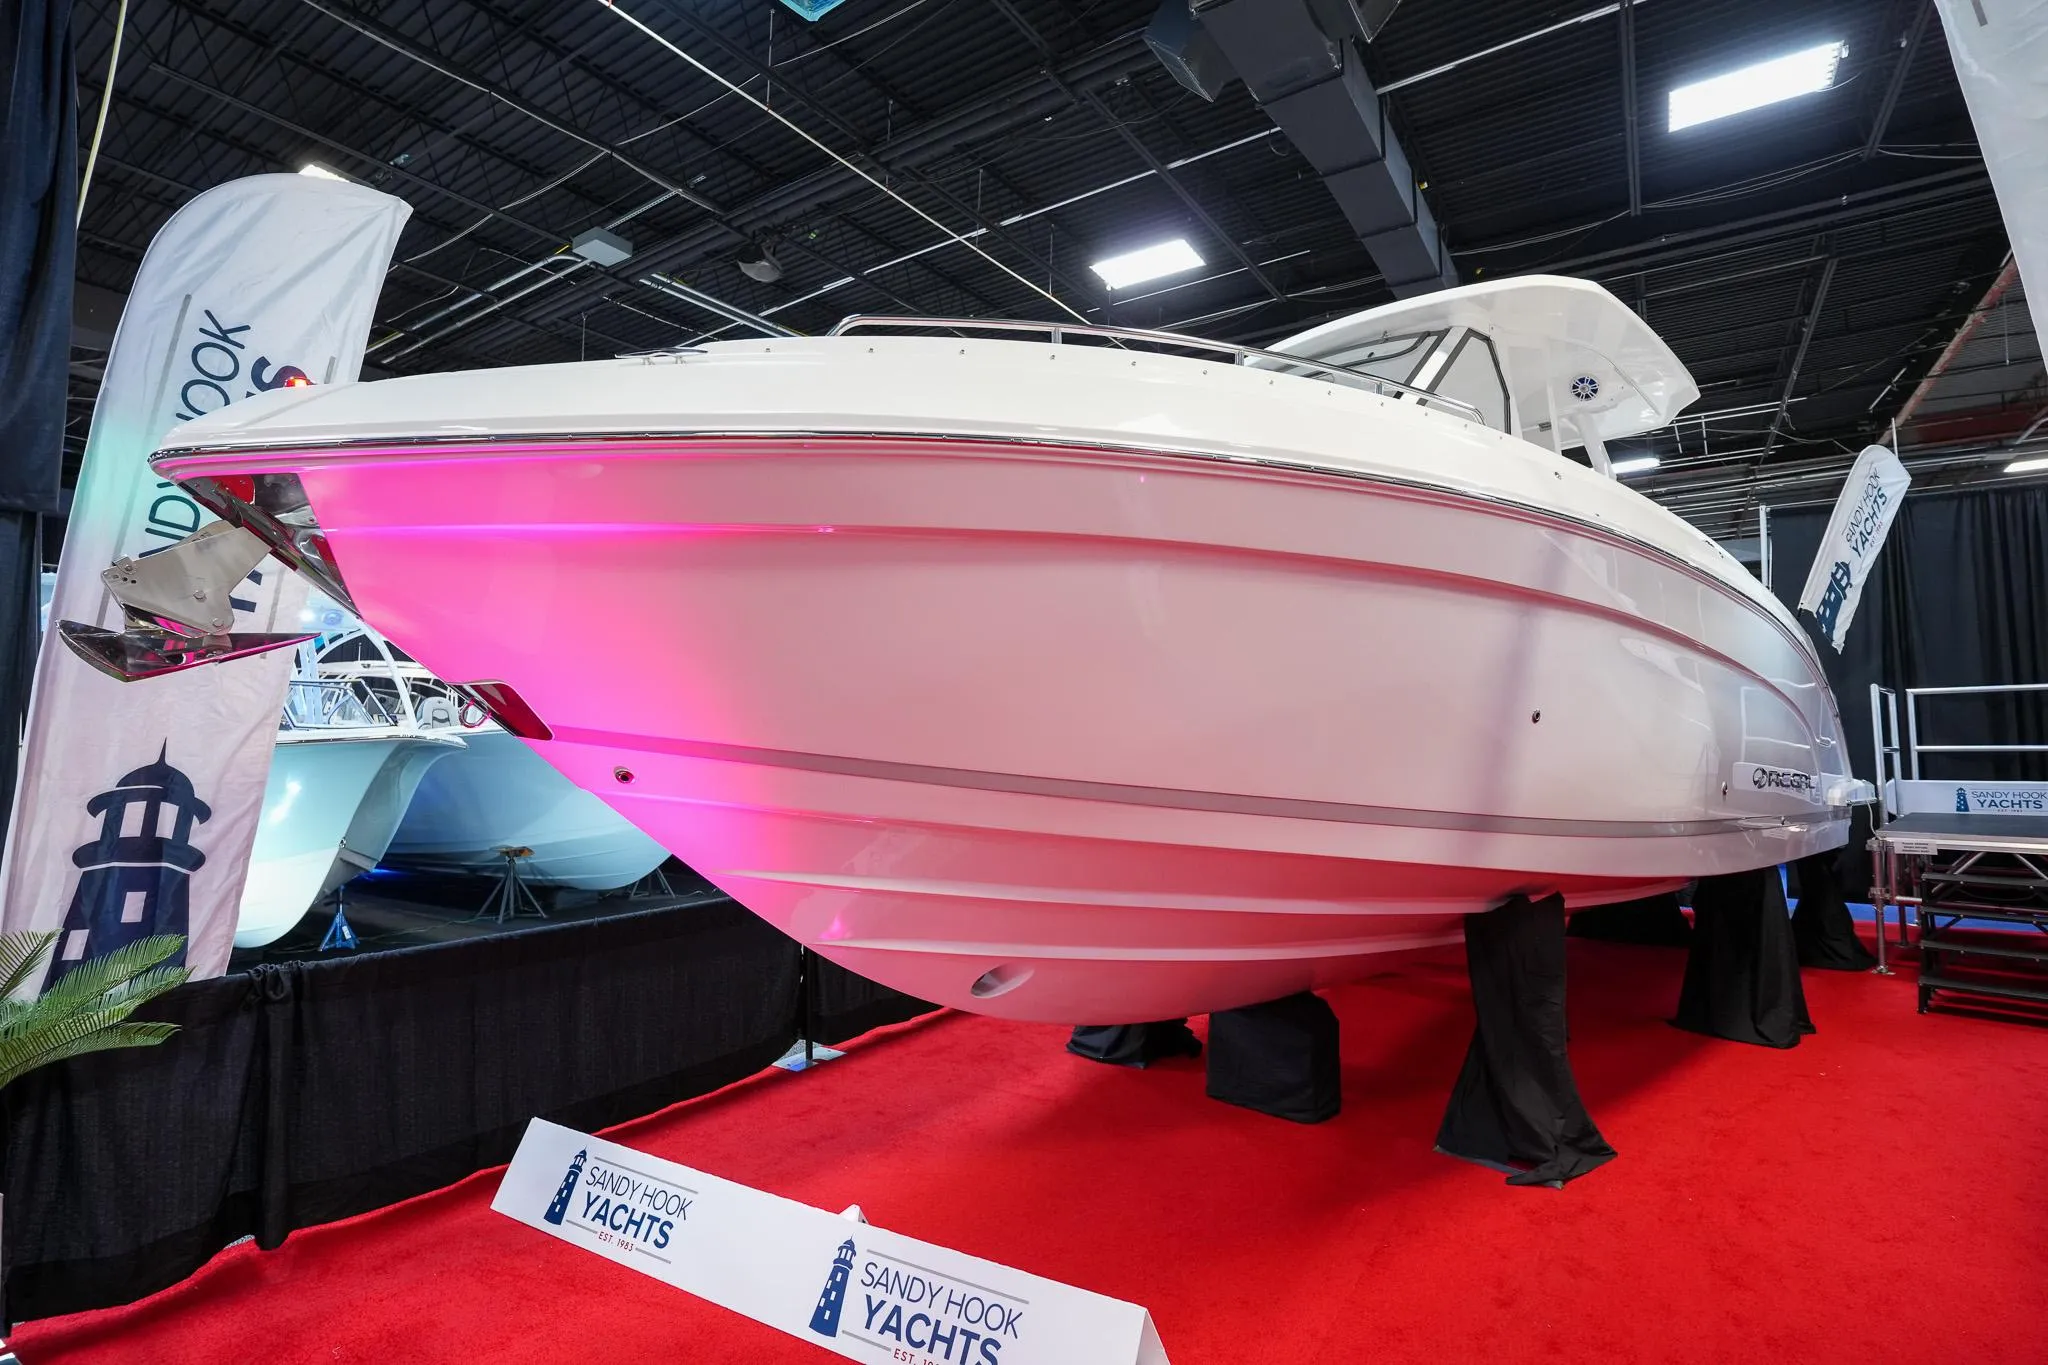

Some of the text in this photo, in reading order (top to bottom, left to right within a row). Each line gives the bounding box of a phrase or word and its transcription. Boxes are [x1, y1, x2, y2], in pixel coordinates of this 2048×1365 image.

[175, 309, 251, 421] OOK
[1846, 467, 1880, 542] SANDY HOOK
[1852, 486, 1887, 558] YACHTS
[1768, 770, 1816, 789] REGAL
[1971, 791, 2048, 799] SANDY HOOK
[1977, 799, 2043, 809] YACHTS
[582, 1191, 674, 1249] YACHTS
[585, 1166, 693, 1221] SANDY HOOK
[617, 1238, 635, 1252] 1983
[860, 1262, 1023, 1340] SANDY HOOK
[864, 1294, 1001, 1365] YACHTS
